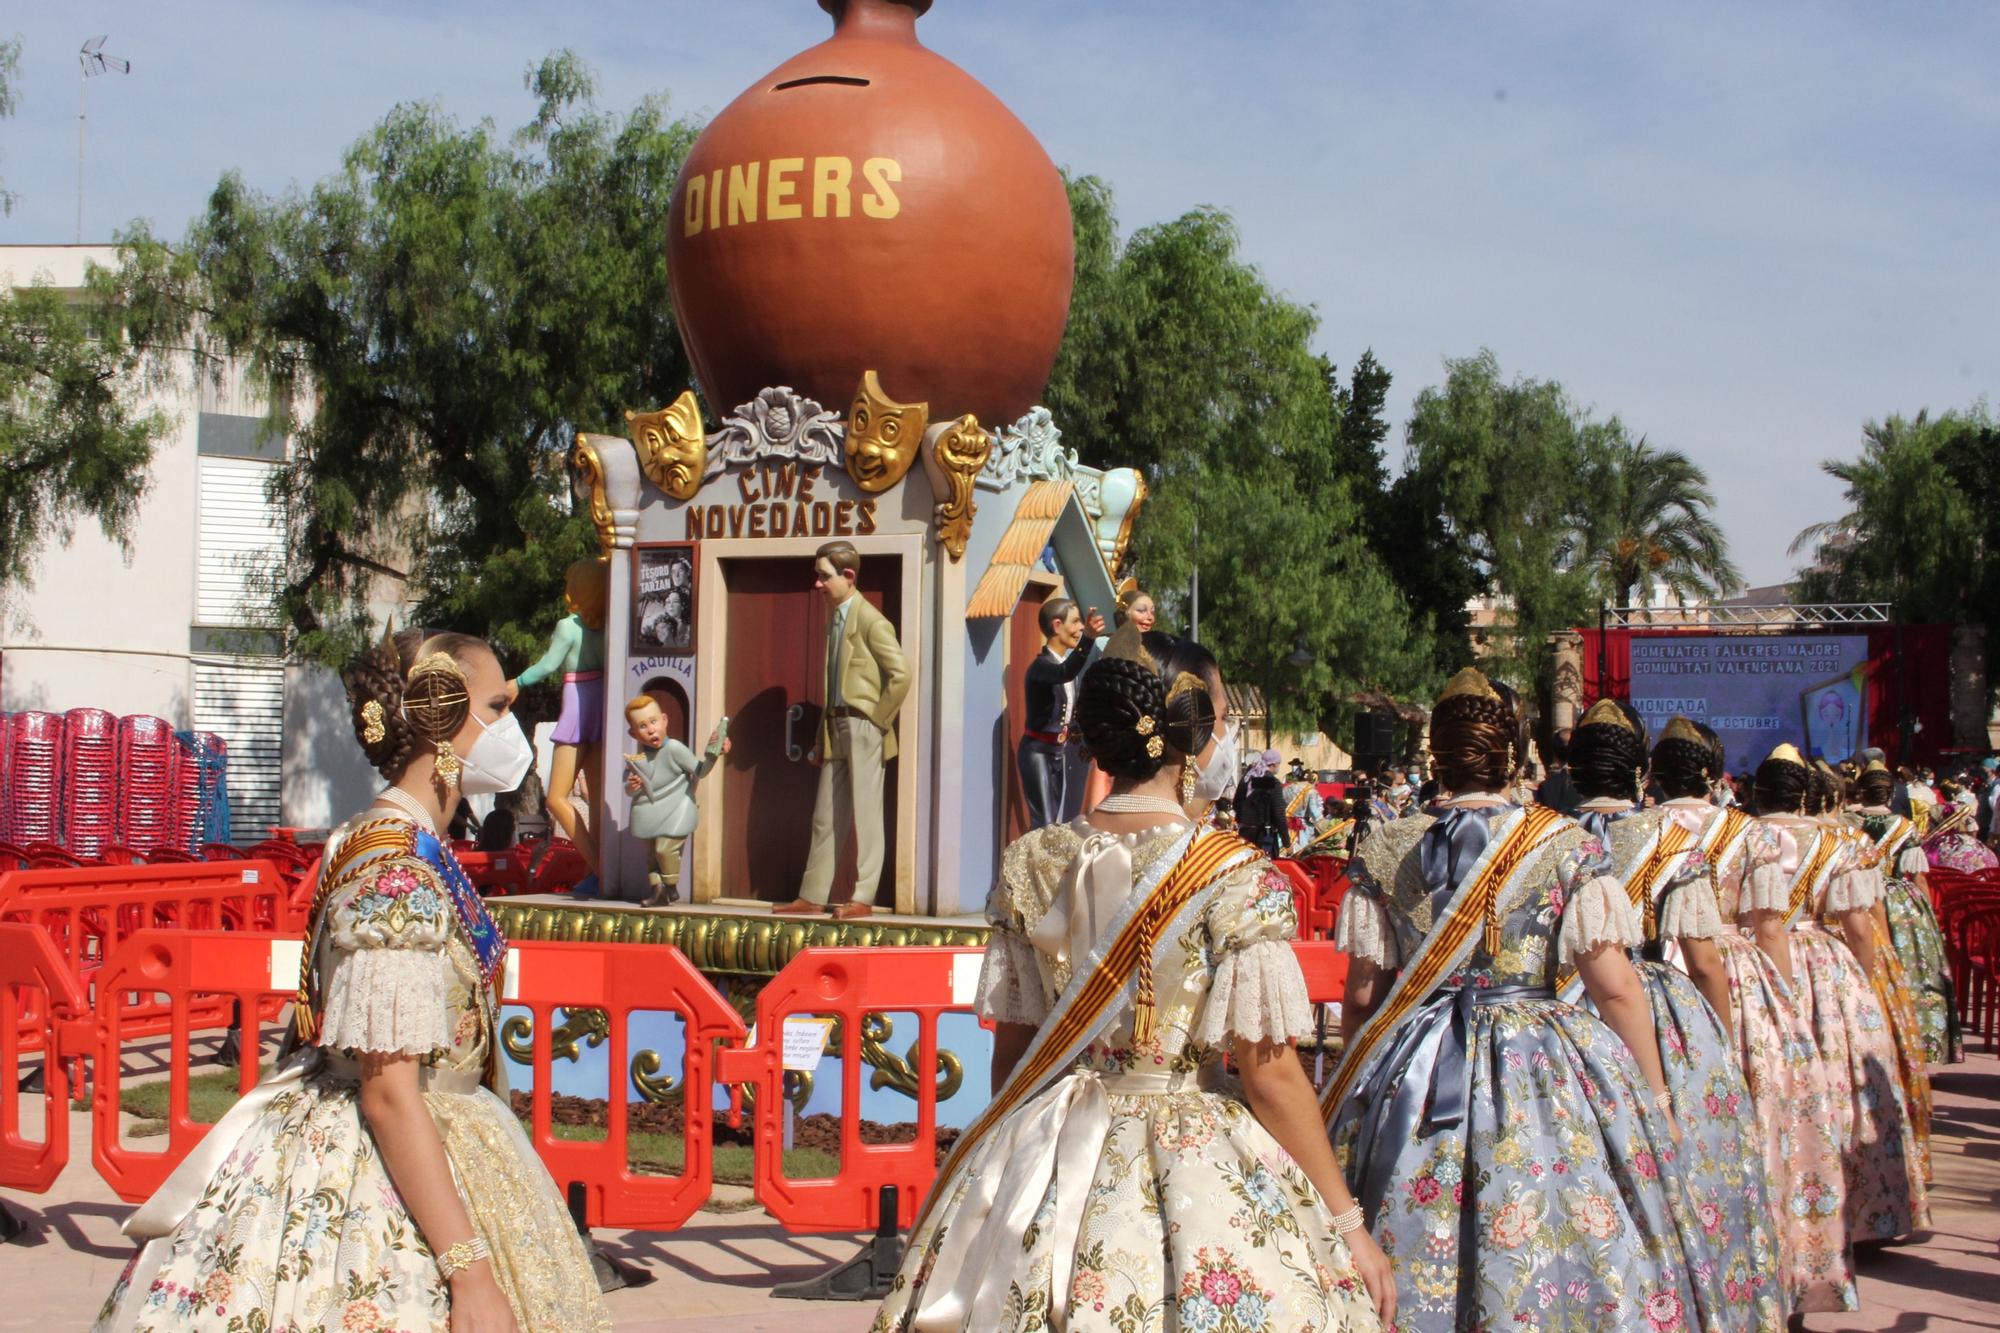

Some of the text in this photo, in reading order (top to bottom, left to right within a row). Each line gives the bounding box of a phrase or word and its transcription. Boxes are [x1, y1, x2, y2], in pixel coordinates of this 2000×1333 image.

[685, 156, 902, 238] DINERS
[737, 461, 821, 505] CINE
[685, 499, 877, 540] NOVEDADES
[641, 564, 669, 580] TESORO
[1633, 644, 1840, 657] HOMENATGE FALLERES MAJORS
[631, 656, 692, 677] TAQUILLA
[1810, 661, 1839, 672] 2021
[1633, 700, 1706, 712] MONCADA
